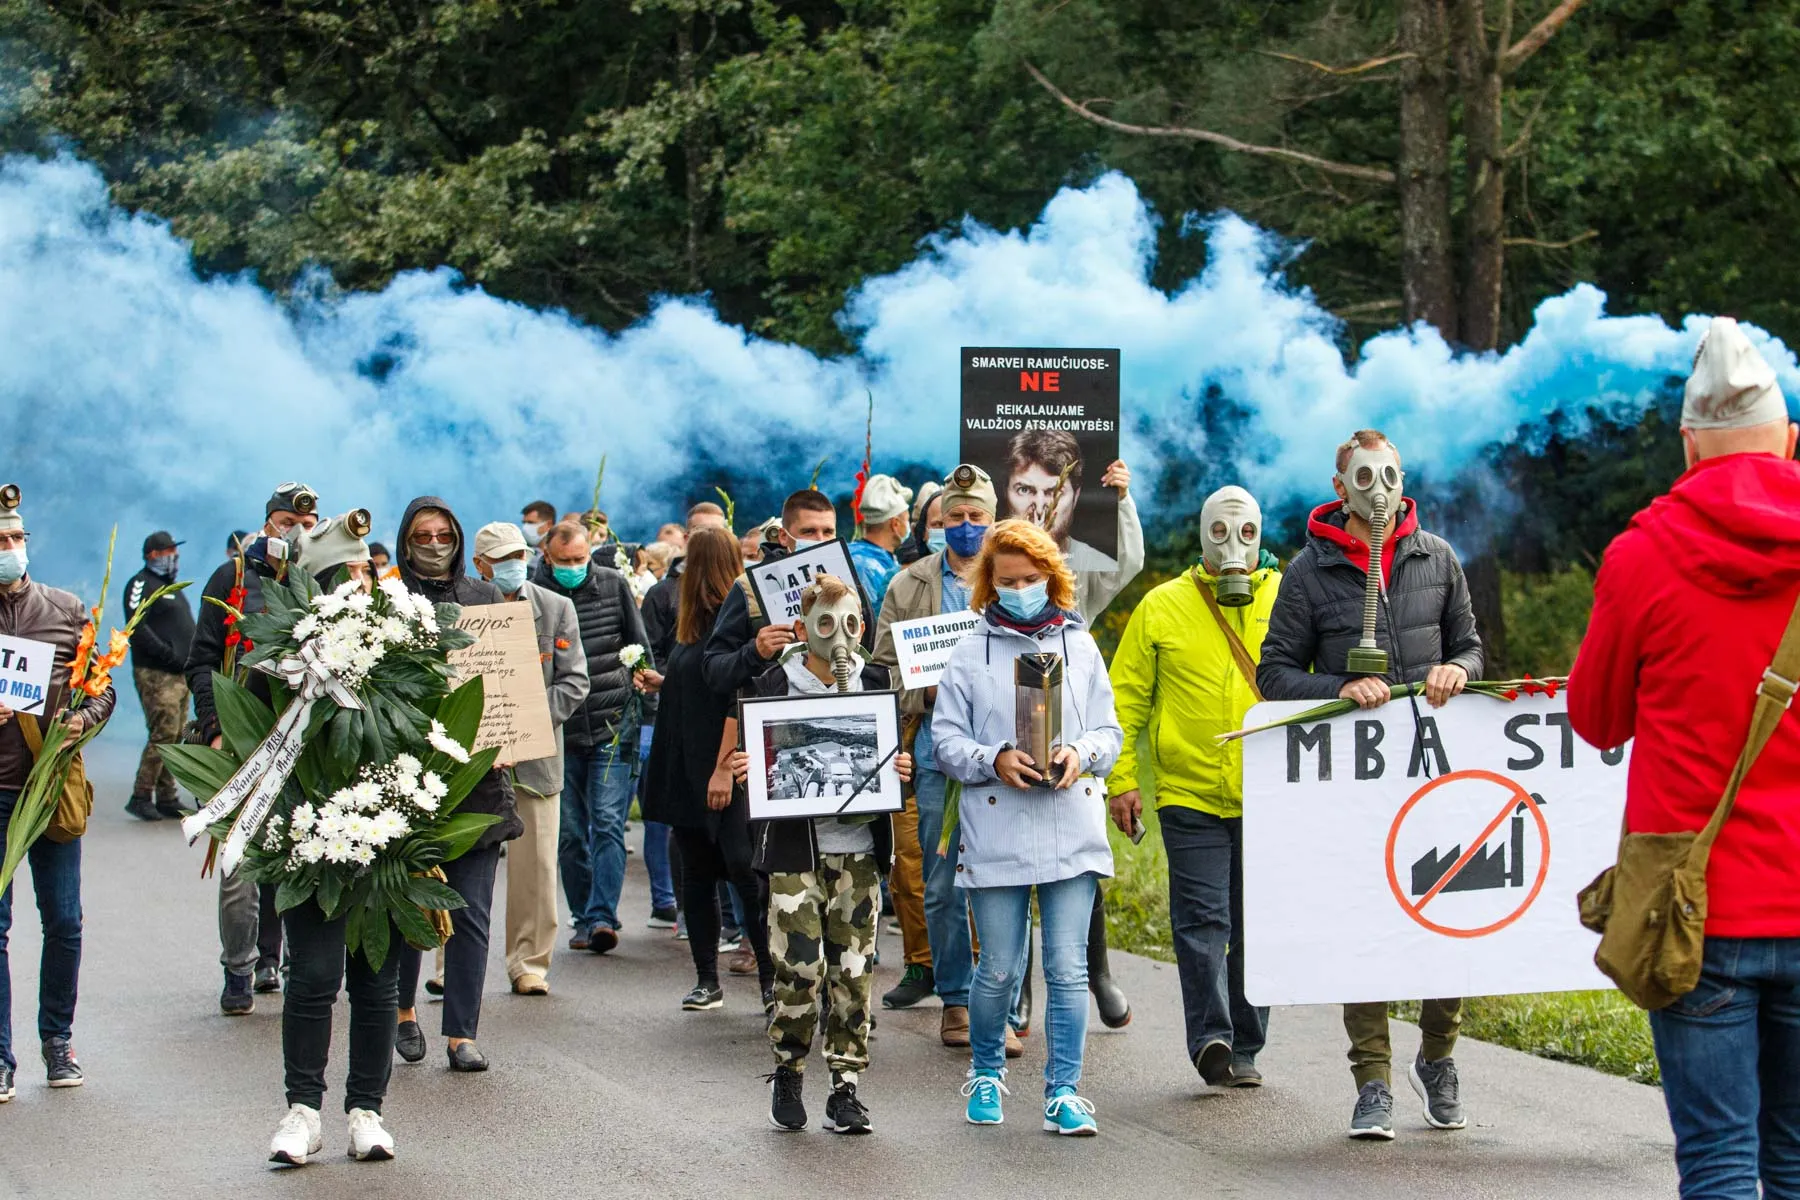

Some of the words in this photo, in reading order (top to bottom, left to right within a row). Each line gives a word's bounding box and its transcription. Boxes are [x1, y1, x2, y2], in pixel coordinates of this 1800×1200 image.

[972, 357, 1024, 369] SMARVEI
[1027, 356, 1110, 370] RAMUČIUOSE-
[1020, 371, 1060, 392] NE
[996, 404, 1085, 416] REIKALAUJAME
[966, 417, 1022, 430] VALDŽIOS
[1025, 418, 1114, 432] ATSAKOMYBĖS!
[903, 626, 931, 640] MBA
[913, 642, 928, 655] jau
[1, 648, 28, 672] TA
[910, 666, 922, 675] AM
[10, 681, 42, 700] MBA
[1286, 716, 1452, 783] MBA
